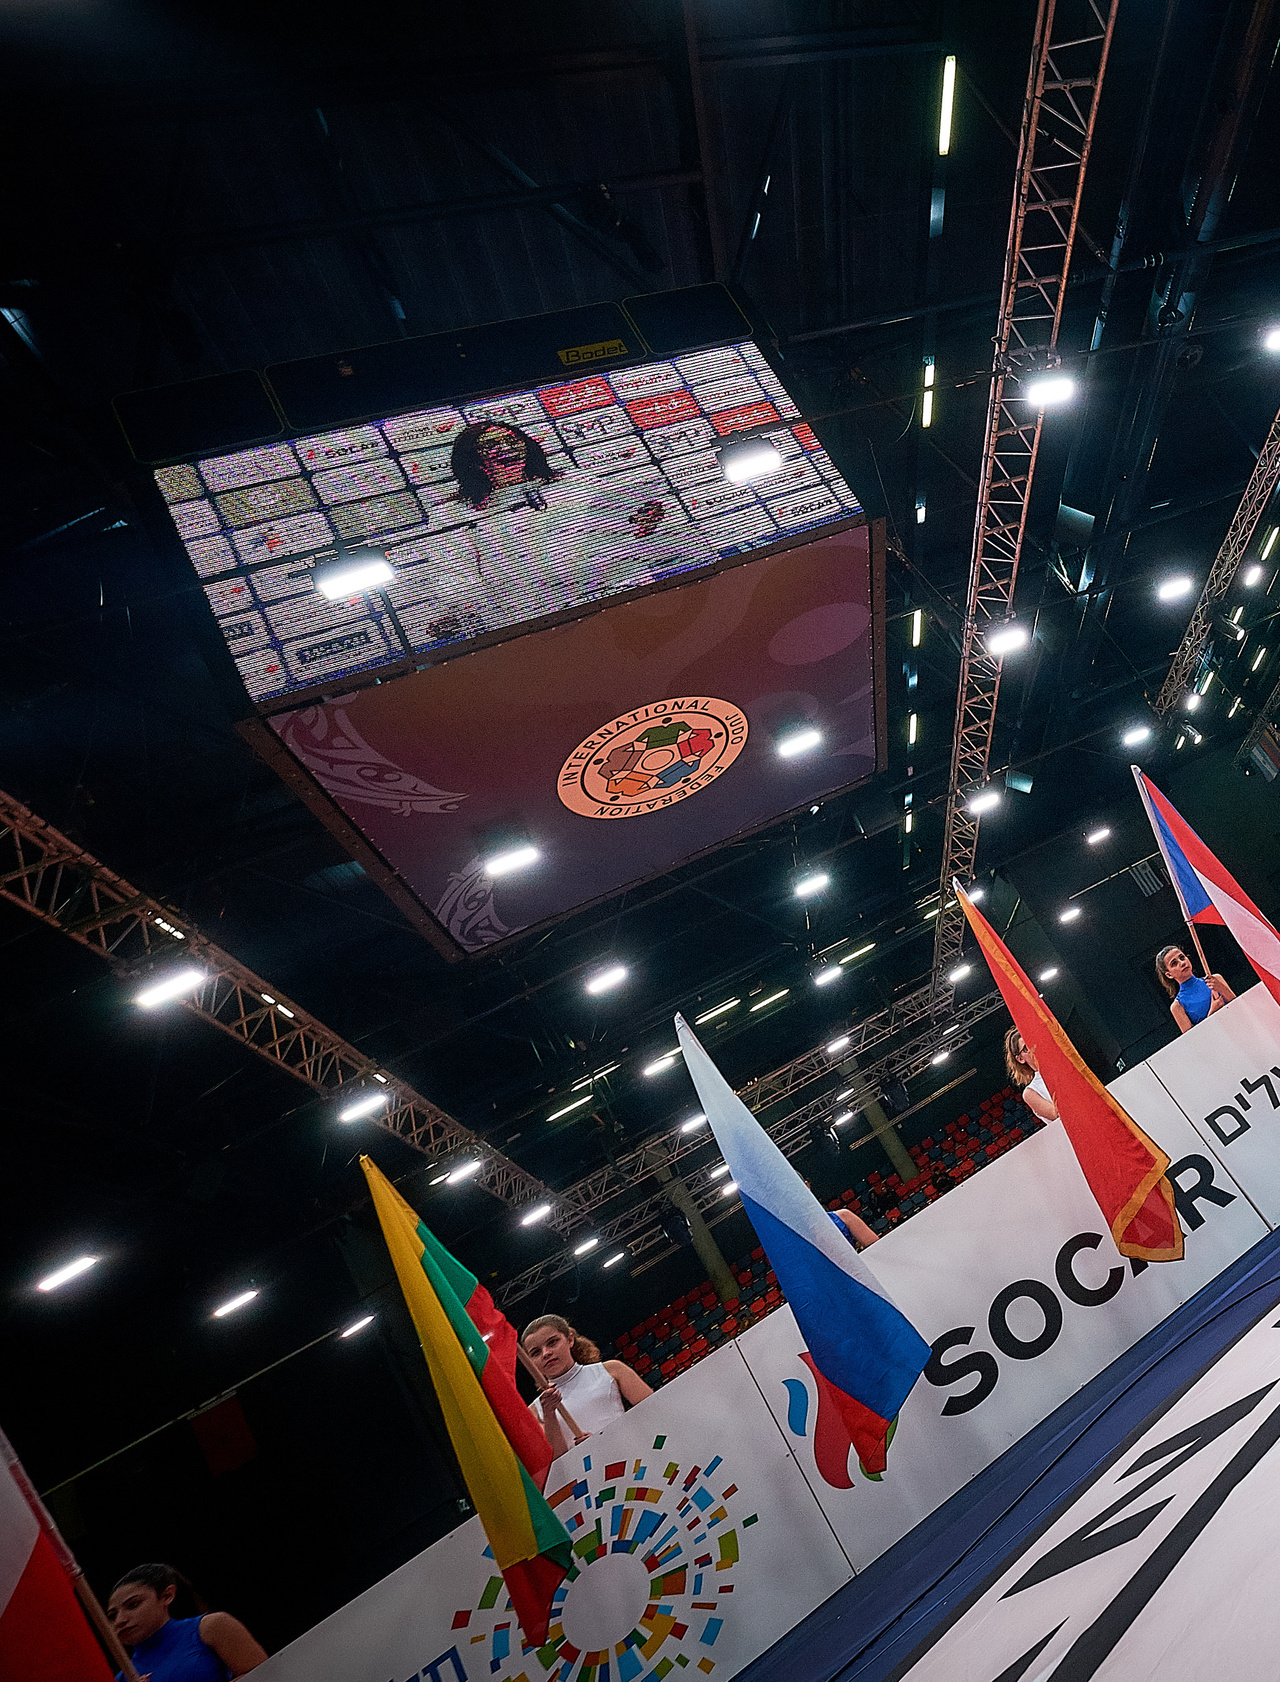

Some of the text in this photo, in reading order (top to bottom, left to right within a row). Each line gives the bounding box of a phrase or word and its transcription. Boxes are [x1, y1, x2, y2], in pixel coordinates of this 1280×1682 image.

[565, 343, 625, 364] Bodet
[562, 700, 744, 816] INTERNATIONAL JUDO FEDERATION
[924, 1154, 1238, 1417] SOCR
